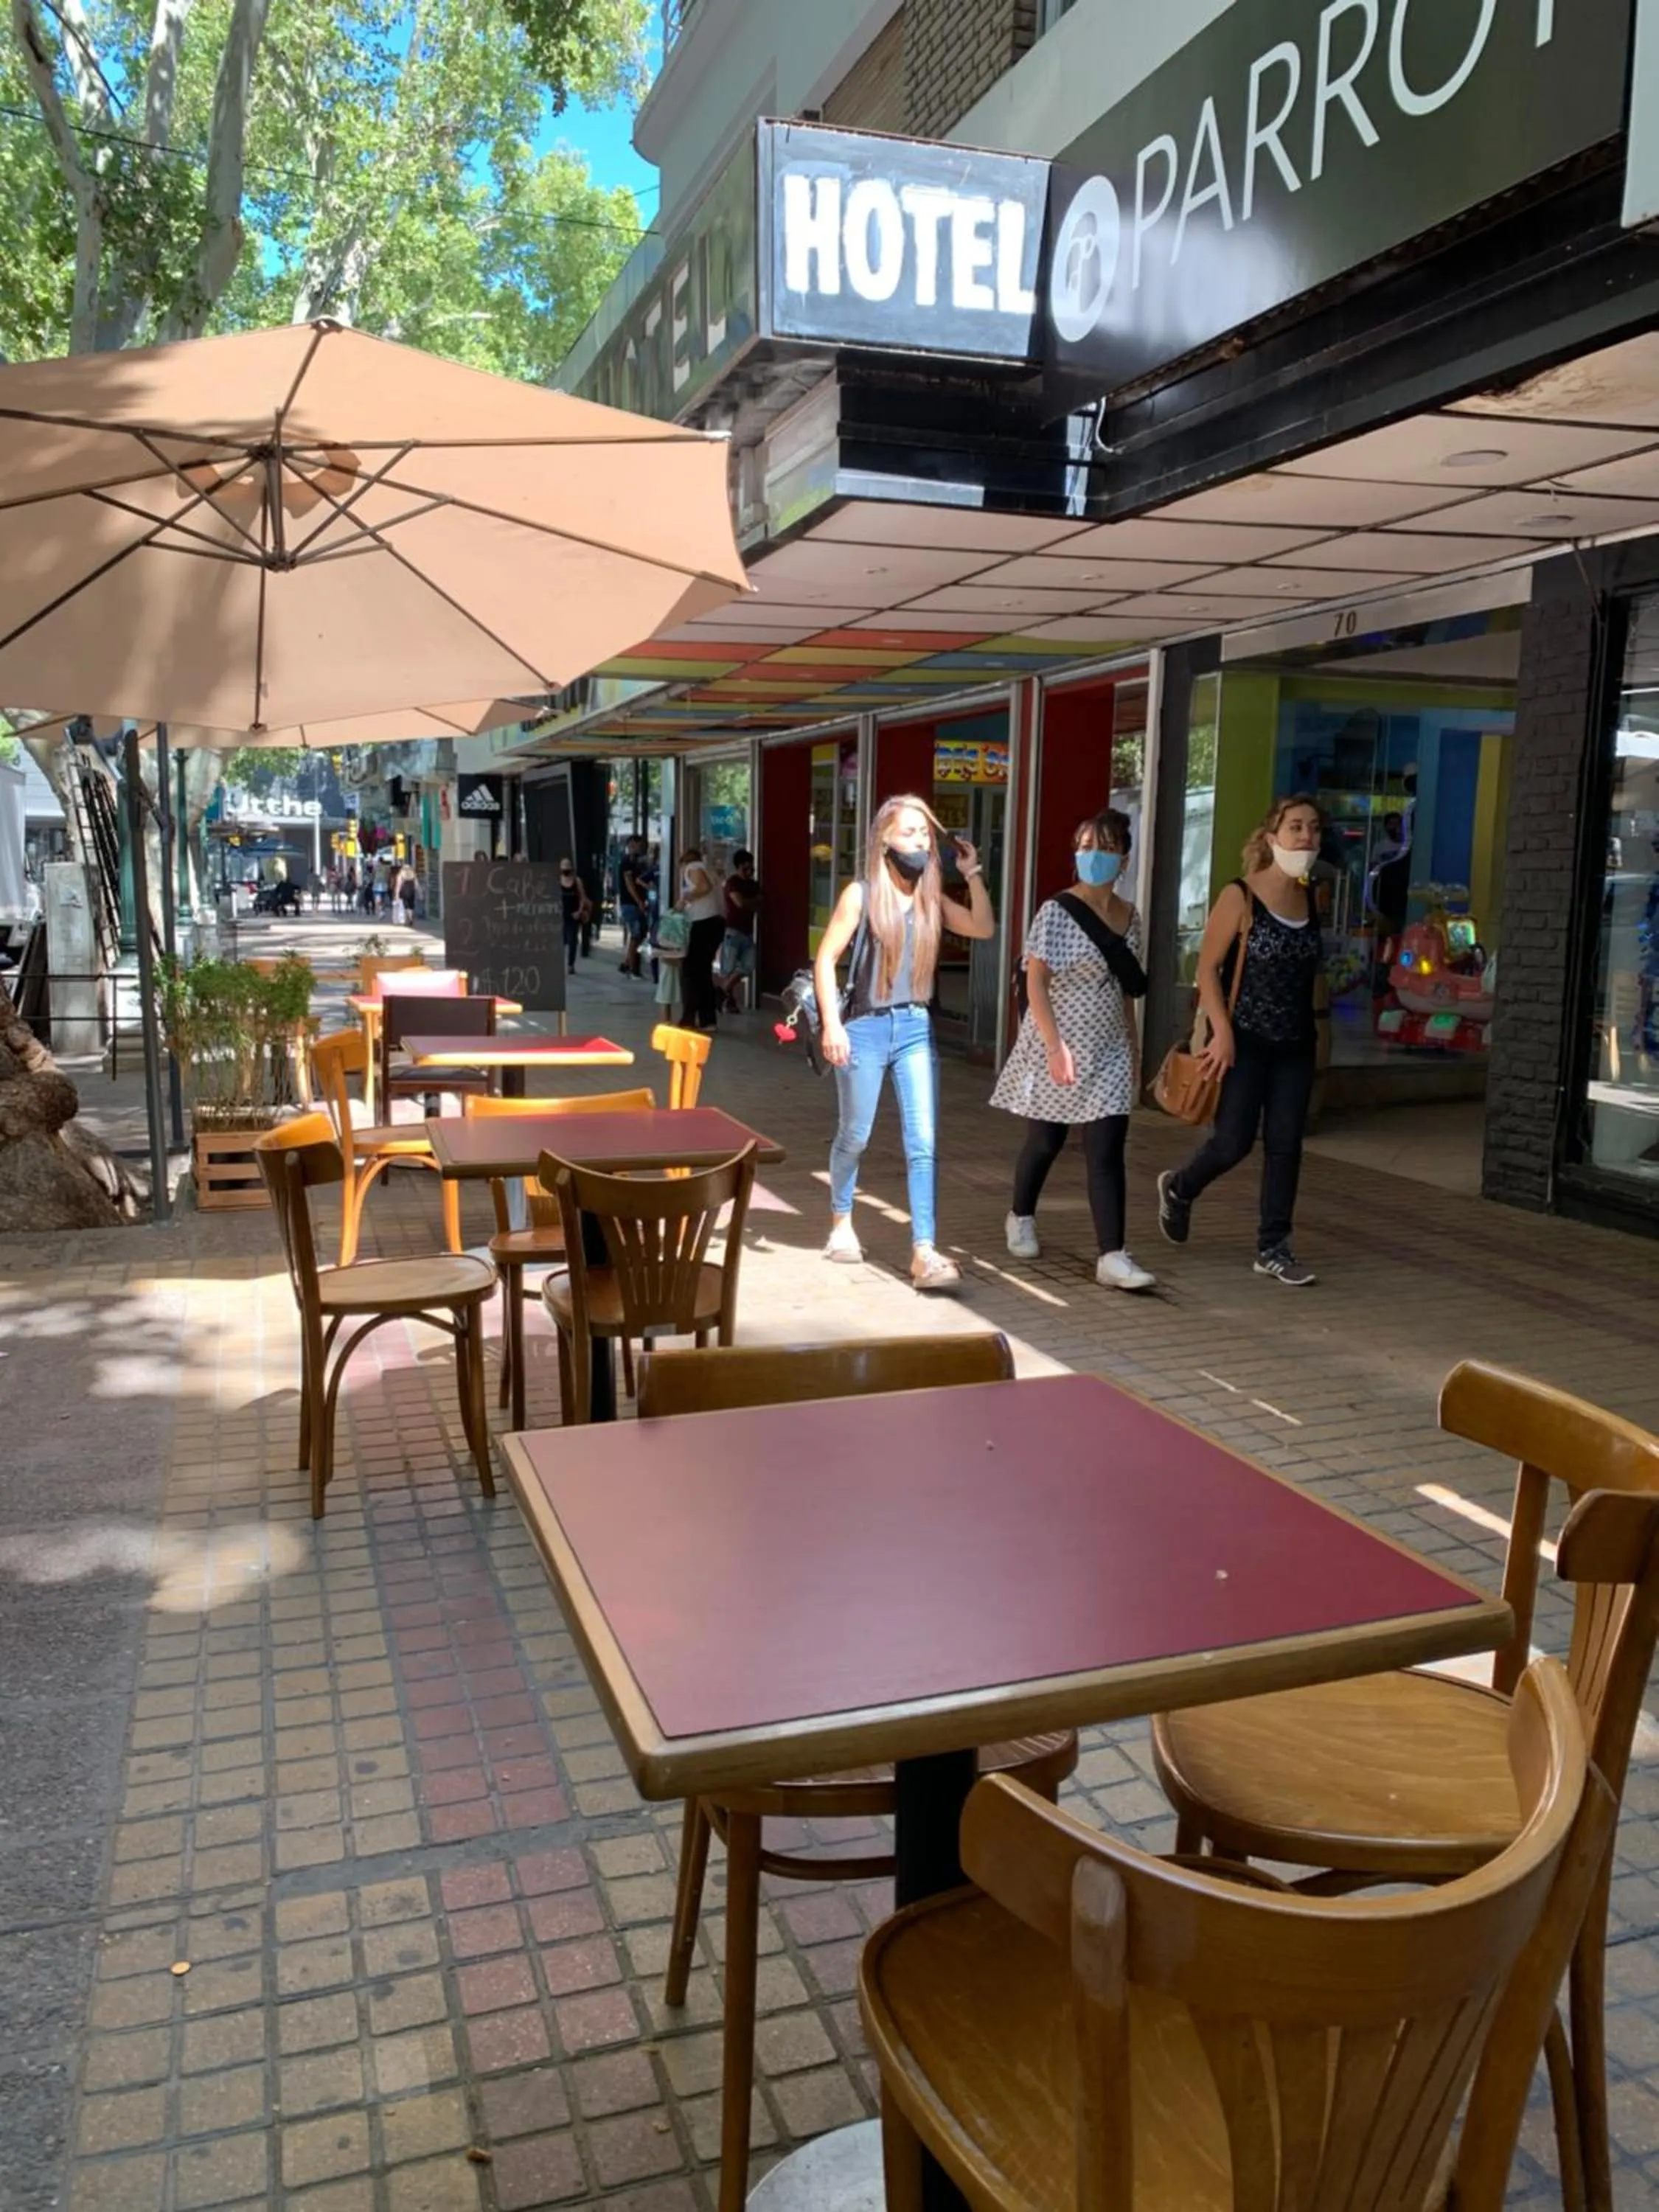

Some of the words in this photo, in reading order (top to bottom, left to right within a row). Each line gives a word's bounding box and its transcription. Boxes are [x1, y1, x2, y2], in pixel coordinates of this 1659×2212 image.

[1131, 0, 1553, 291] PARRO
[784, 174, 1035, 314] HOTEL
[1334, 611, 1357, 637] 70
[462, 801, 500, 810] adidas
